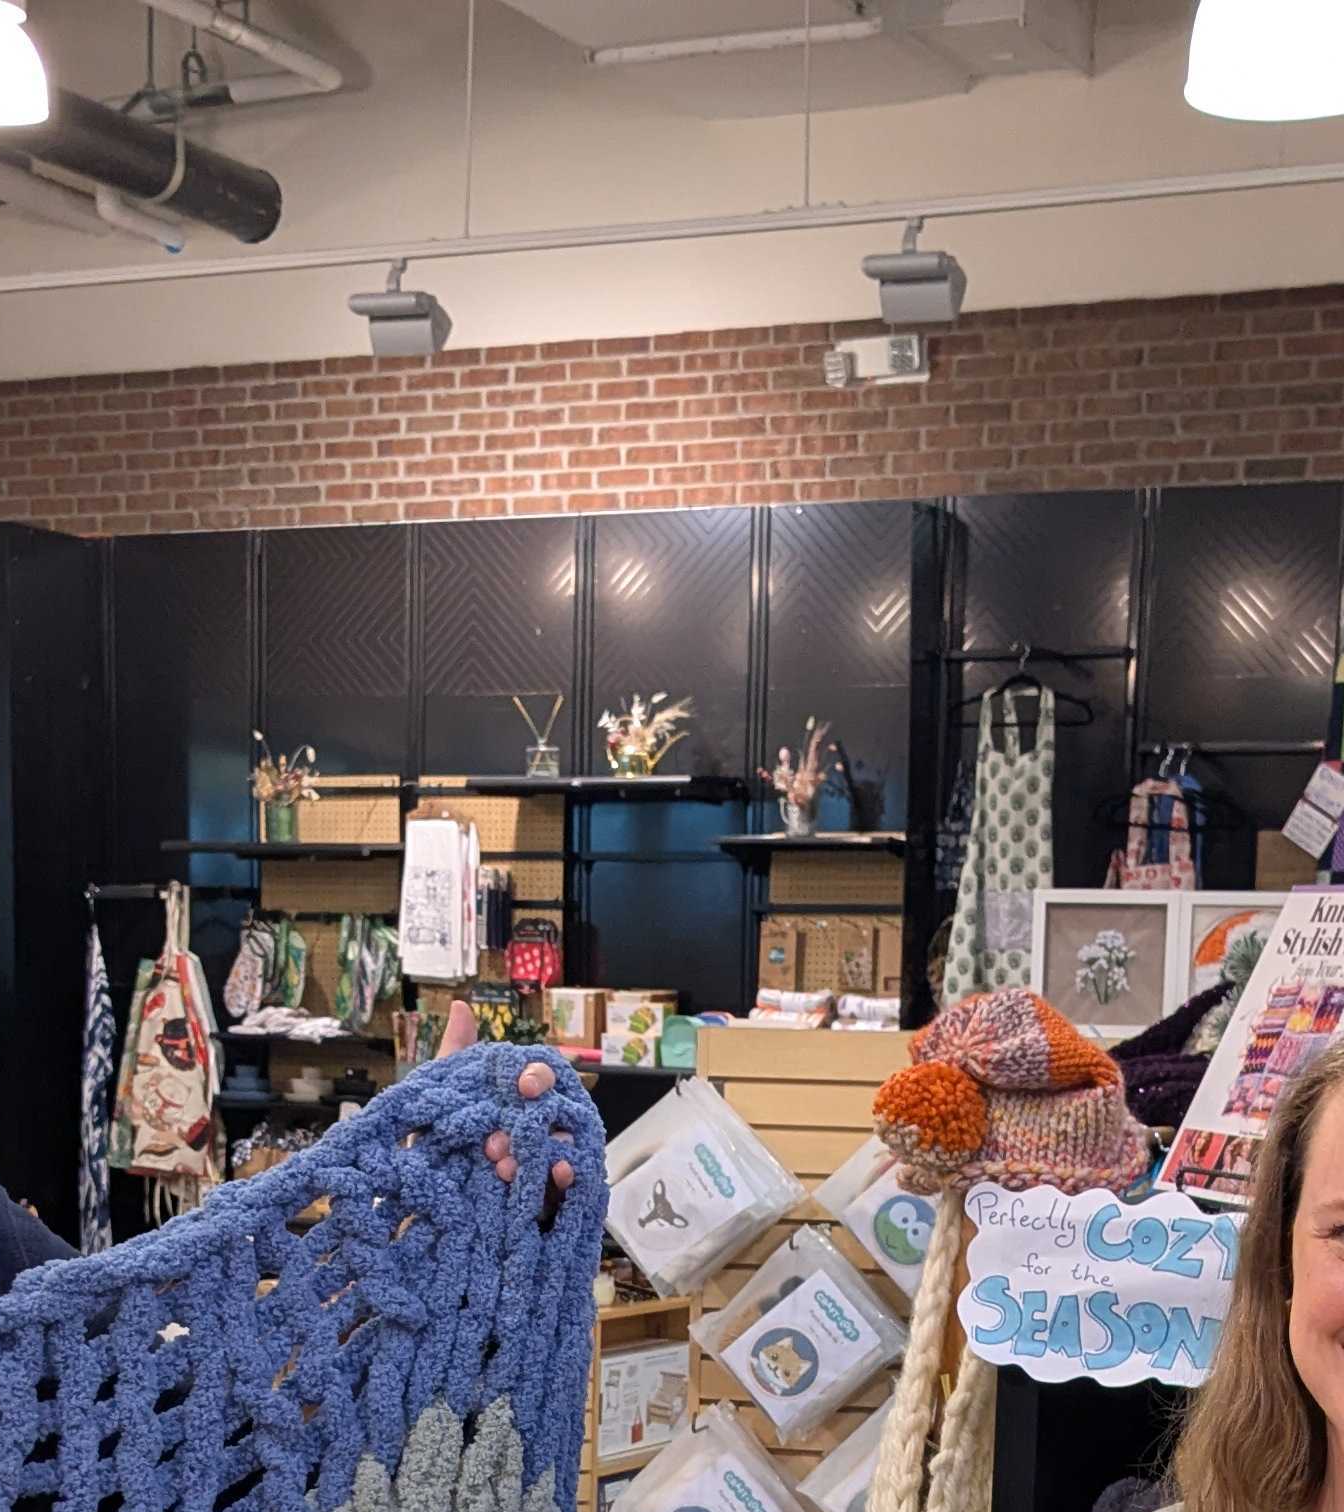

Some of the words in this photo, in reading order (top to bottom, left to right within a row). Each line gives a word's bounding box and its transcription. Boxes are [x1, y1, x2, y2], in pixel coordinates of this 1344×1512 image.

[1277, 927, 1343, 964] Stylish
[968, 1191, 1076, 1248] Perfectly
[1020, 1252, 1052, 1275] for
[1071, 1263, 1114, 1287] the
[971, 1275, 1224, 1370] SEASON
